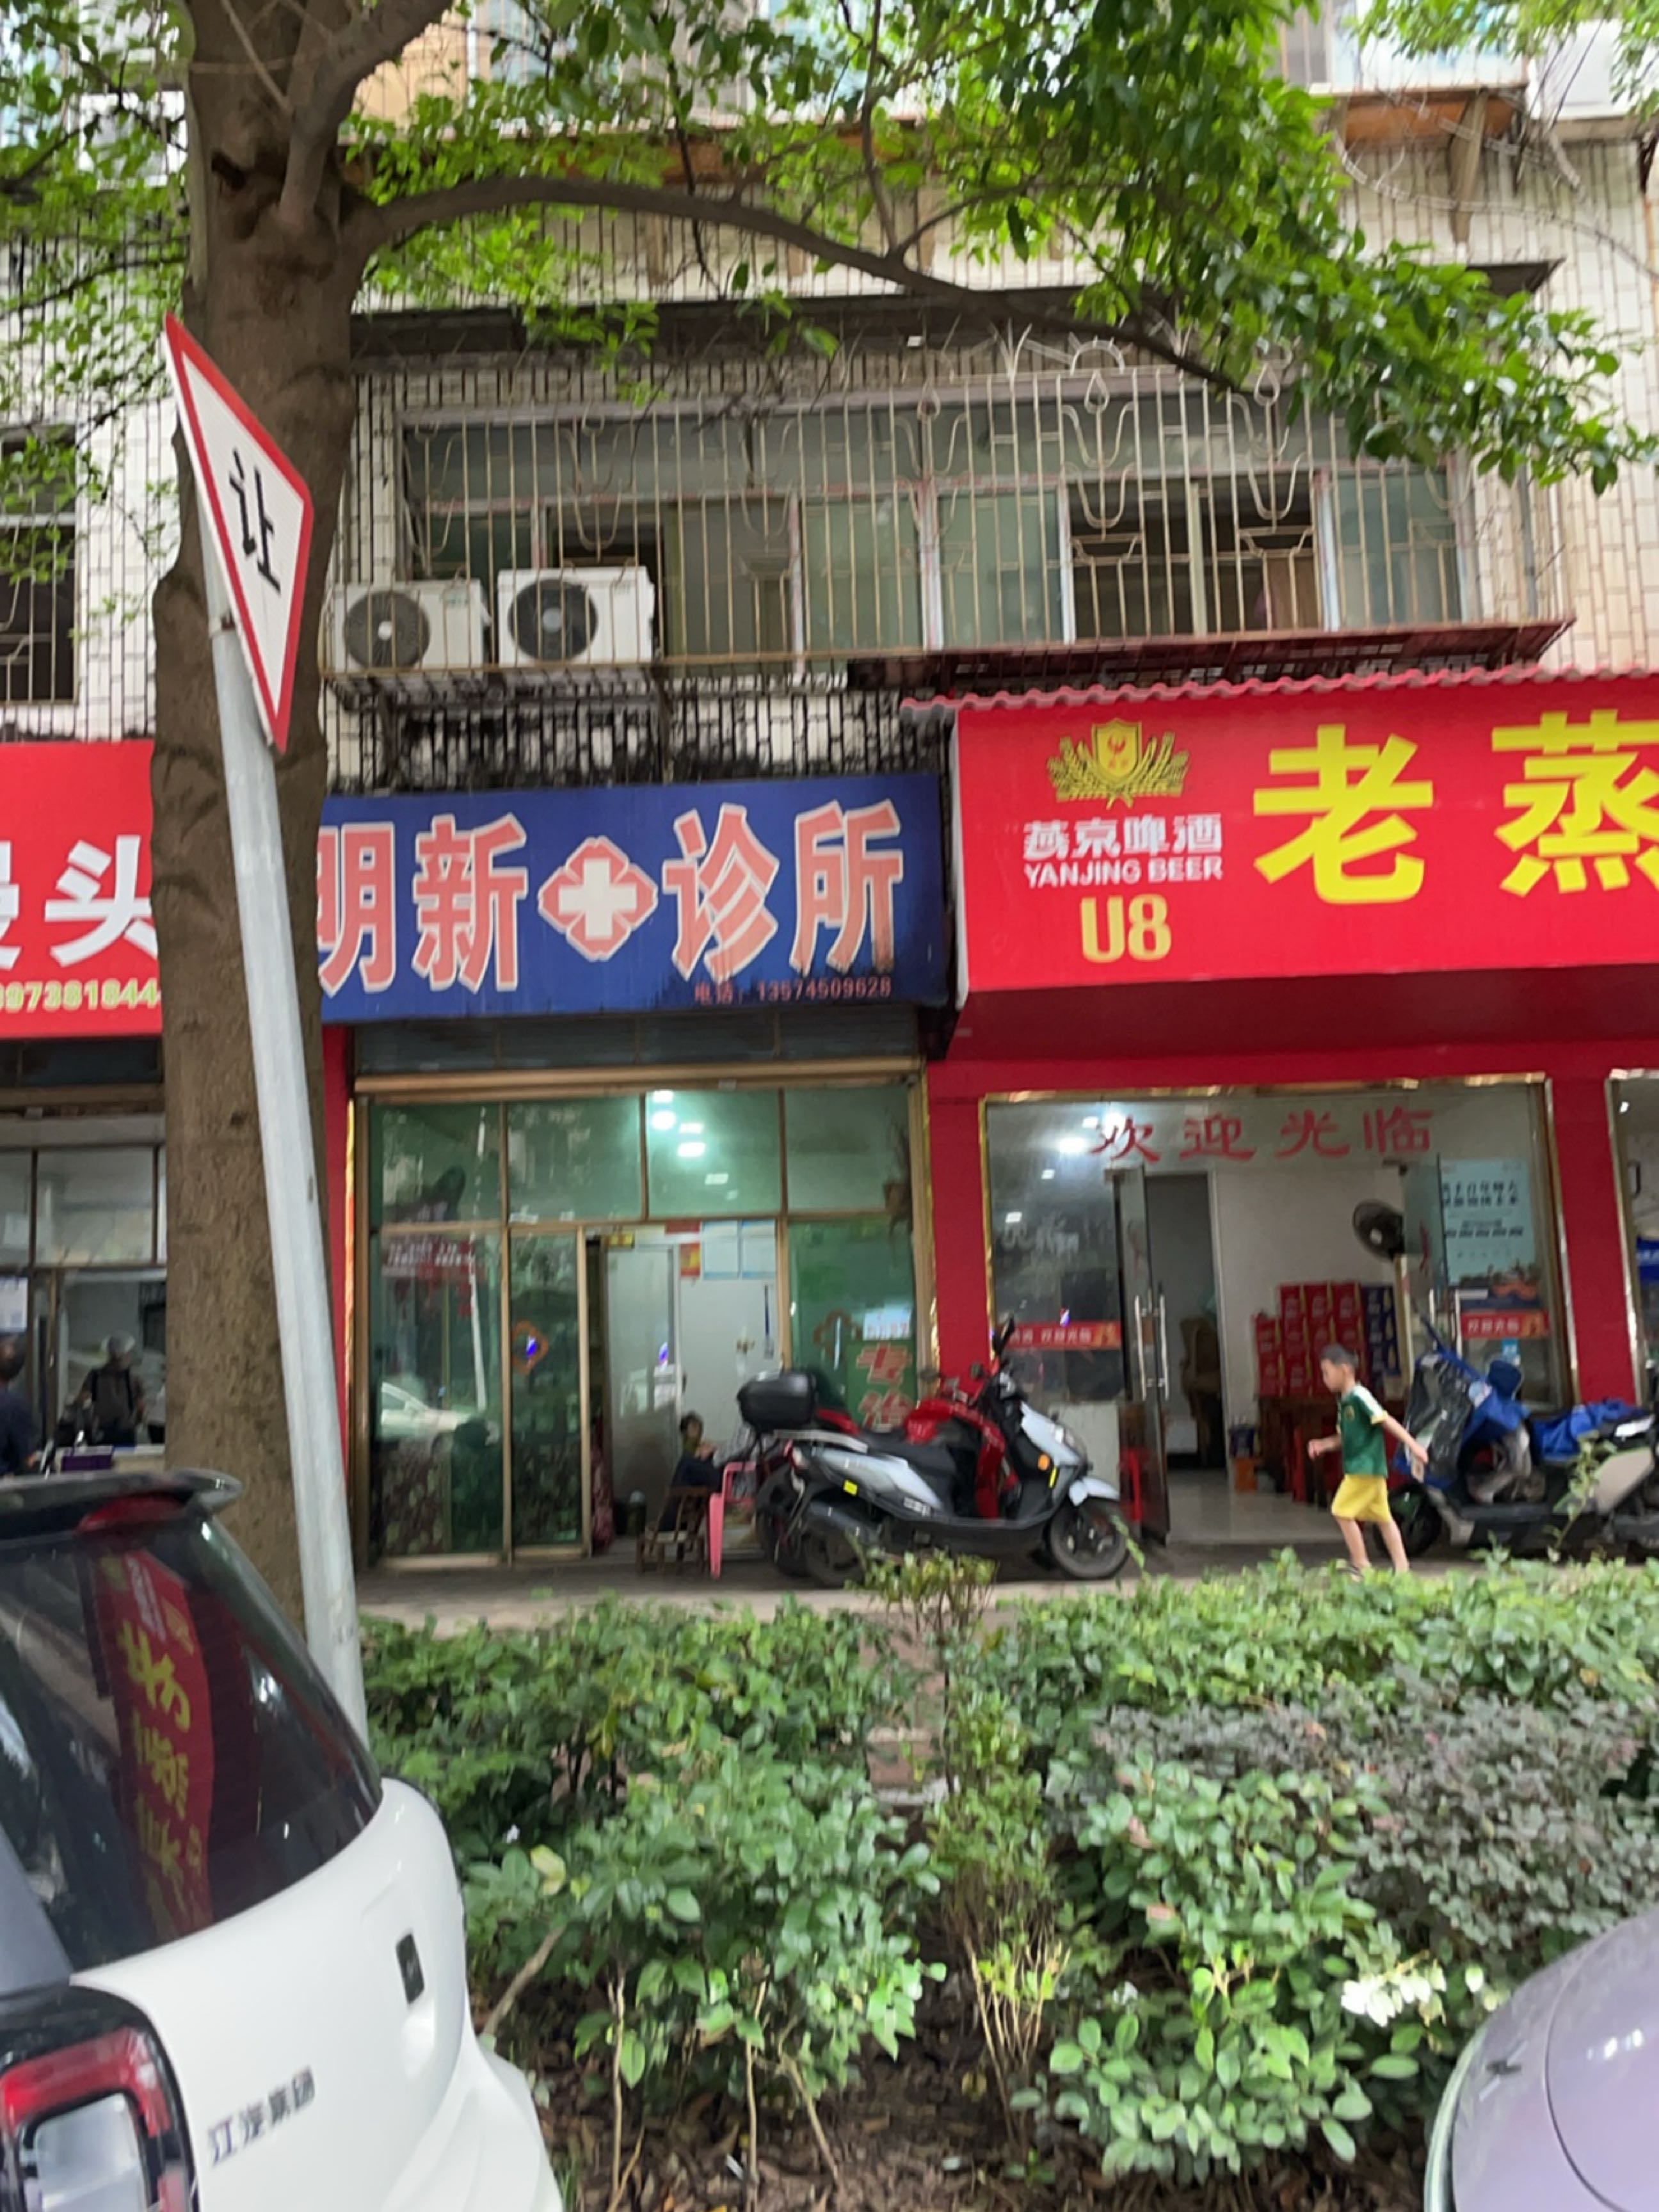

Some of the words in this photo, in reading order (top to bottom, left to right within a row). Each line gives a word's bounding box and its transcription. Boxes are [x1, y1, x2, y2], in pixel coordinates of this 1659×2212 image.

[228, 447, 282, 598] 让
[1023, 813, 1222, 862] 燕京啤酒
[1253, 709, 1659, 905] 老蒸
[0, 835, 159, 970] 头
[662, 799, 904, 986] 诊所
[1024, 858, 1142, 889] YANJING
[1148, 854, 1223, 884] BEER
[1080, 894, 1172, 964] U8
[1089, 1105, 1434, 1162] 欢迎光临
